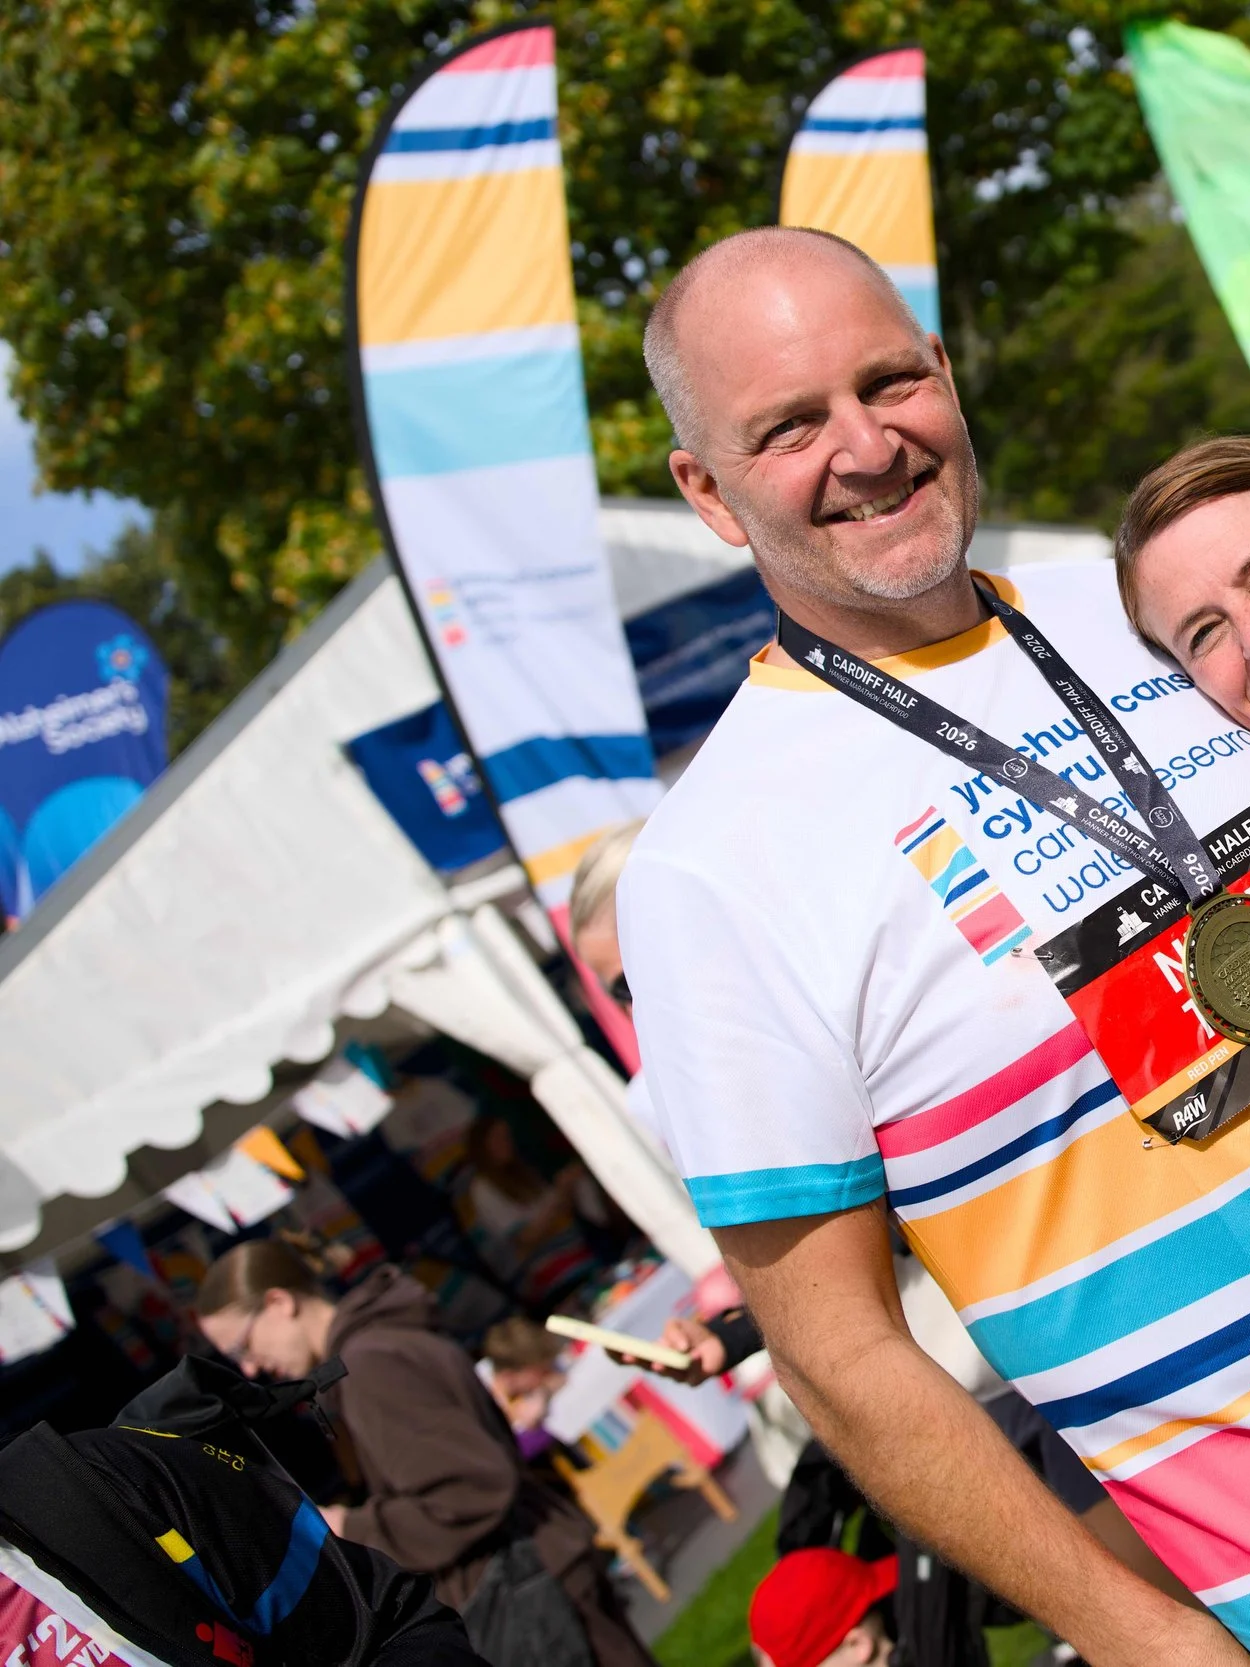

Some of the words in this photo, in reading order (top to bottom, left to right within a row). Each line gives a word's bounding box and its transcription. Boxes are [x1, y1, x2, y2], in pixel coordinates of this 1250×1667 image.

[1022, 633, 1052, 660] 2026
[828, 668, 850, 685] HANNER
[849, 680, 880, 702] MARATHON
[878, 698, 909, 719] CAERDYDD
[832, 654, 884, 689] CARDIFF
[882, 682, 918, 709] HALF
[1056, 679, 1085, 706] HALF
[1110, 673, 1195, 713] cans
[936, 721, 978, 751] 2026
[1077, 704, 1119, 754] CARDIFF
[983, 755, 1107, 840] cyru
[1014, 790, 1138, 875] caner
[1080, 817, 1109, 840] HANNER
[1108, 834, 1146, 865] MARATHON
[1145, 859, 1179, 888] CAERDYDD
[1088, 807, 1150, 851] CARDIFF
[1147, 846, 1179, 877] HAL
[1043, 849, 1135, 913] wale
[1182, 853, 1214, 896] 2026
[1153, 897, 1181, 920] HANNE
[1186, 1059, 1209, 1081] RED
[1207, 1046, 1230, 1068] PEN
[1172, 1094, 1208, 1131] R4W
